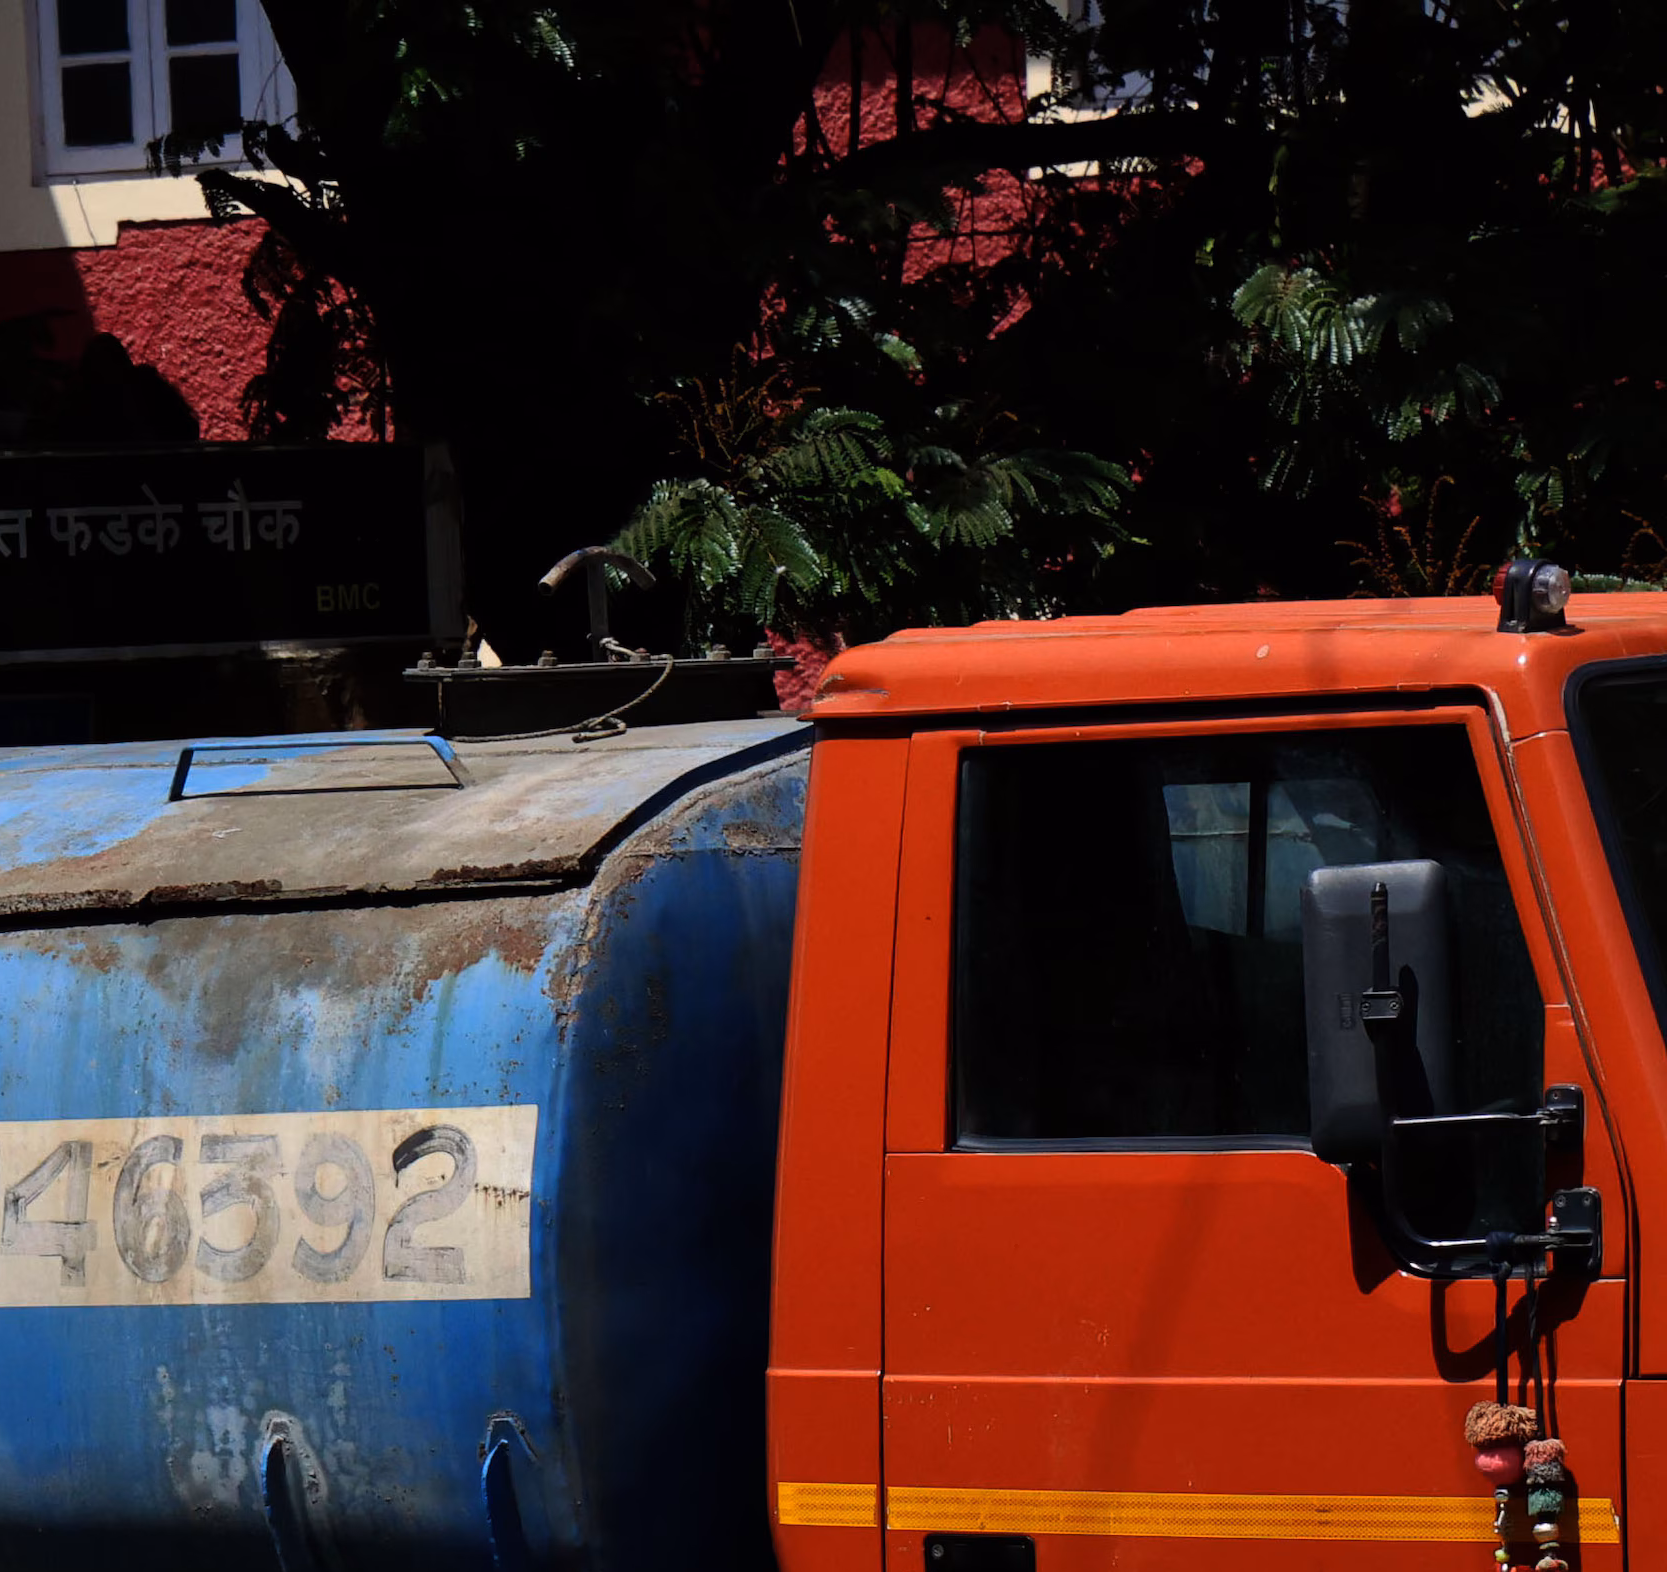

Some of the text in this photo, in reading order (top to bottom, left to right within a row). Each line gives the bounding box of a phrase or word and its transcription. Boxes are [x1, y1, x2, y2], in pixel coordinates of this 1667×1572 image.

[45, 482, 184, 557] फडके
[197, 477, 303, 553] चौक
[316, 581, 381, 614] BMC
